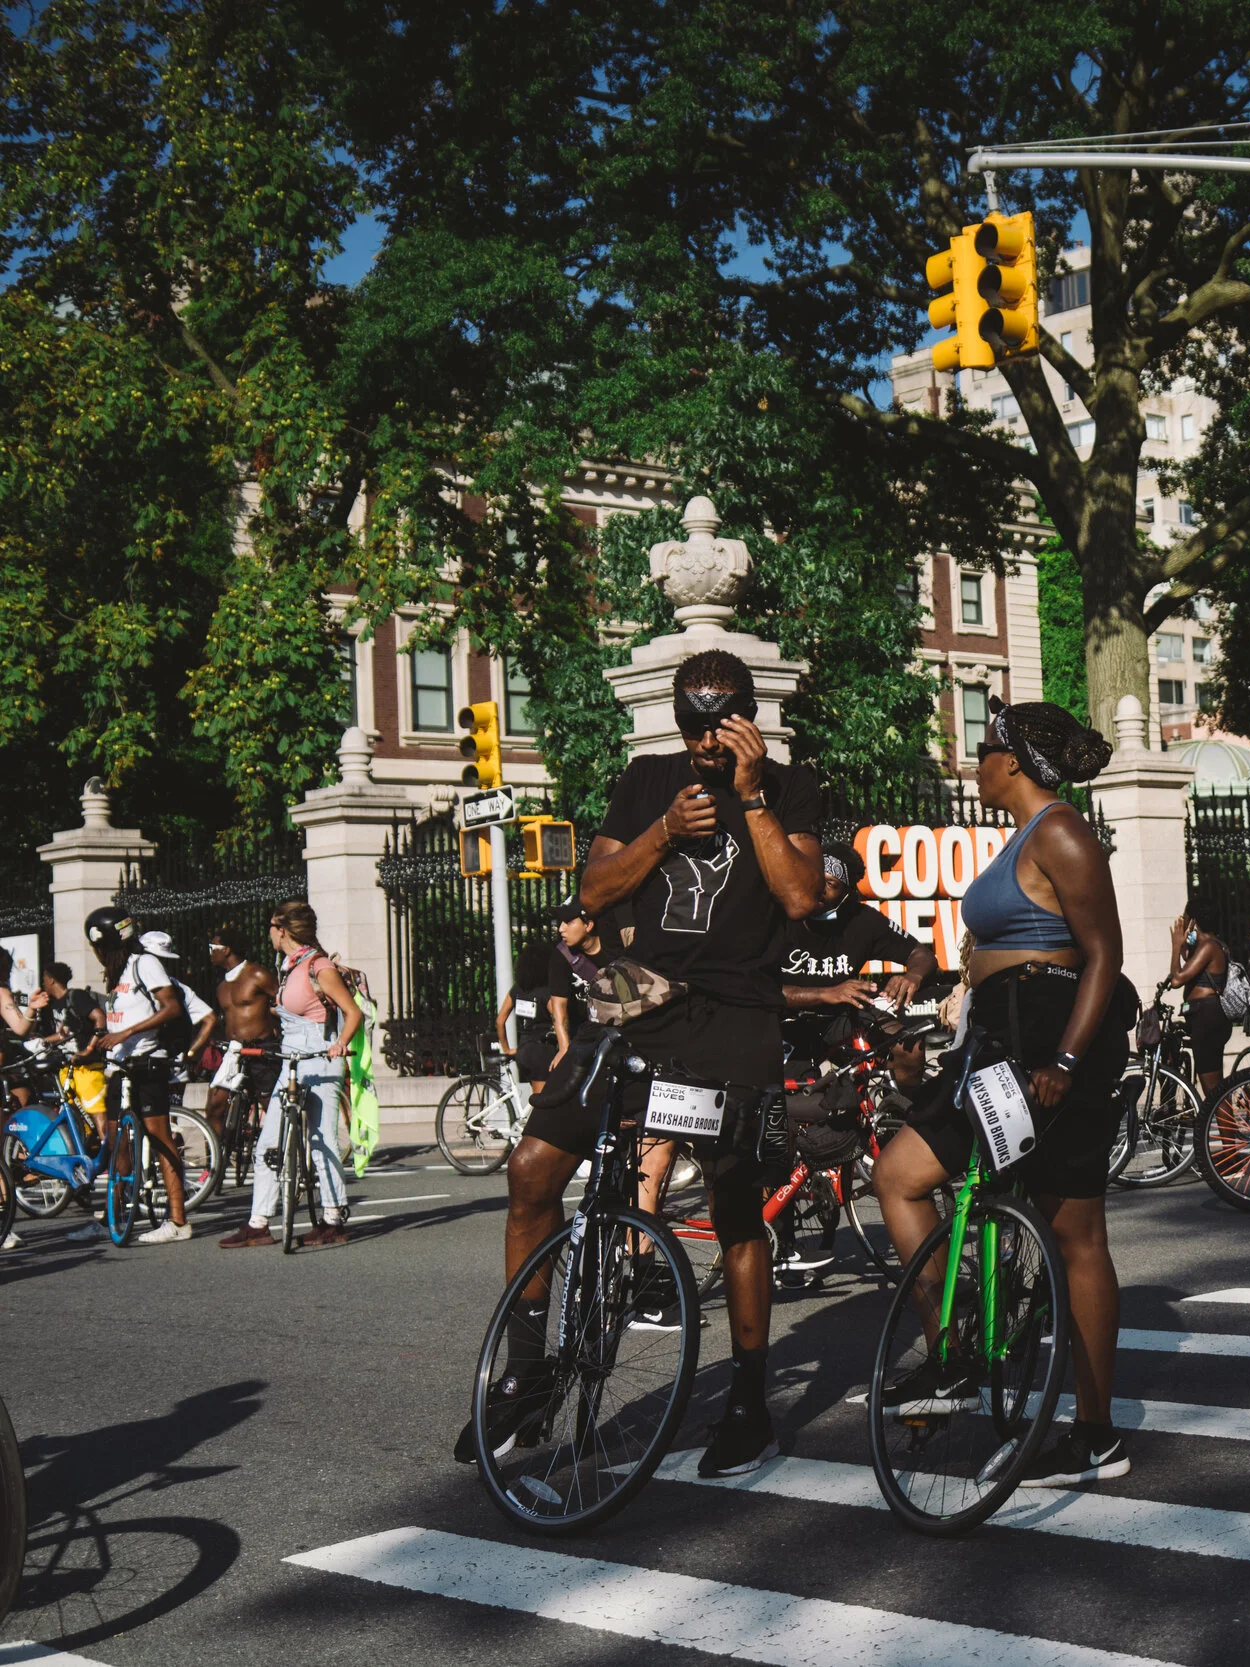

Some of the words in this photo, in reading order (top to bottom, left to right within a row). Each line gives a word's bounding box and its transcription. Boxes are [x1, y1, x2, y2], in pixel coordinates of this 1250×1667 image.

[466, 802, 481, 818] ONE
[488, 799, 505, 813] WAY
[866, 824, 1017, 899] COOP
[652, 1085, 686, 1095] BLACK
[652, 1091, 685, 1101] LIVES
[993, 1066, 1013, 1100] LIVES
[998, 1064, 1017, 1096] BLACK
[650, 1111, 694, 1128] RAYSHARD
[694, 1117, 720, 1131] BROOKS
[969, 1075, 1000, 1126] RAYSHARD
[990, 1125, 1011, 1164] BROOKS
[558, 1249, 574, 1347] cannondale
